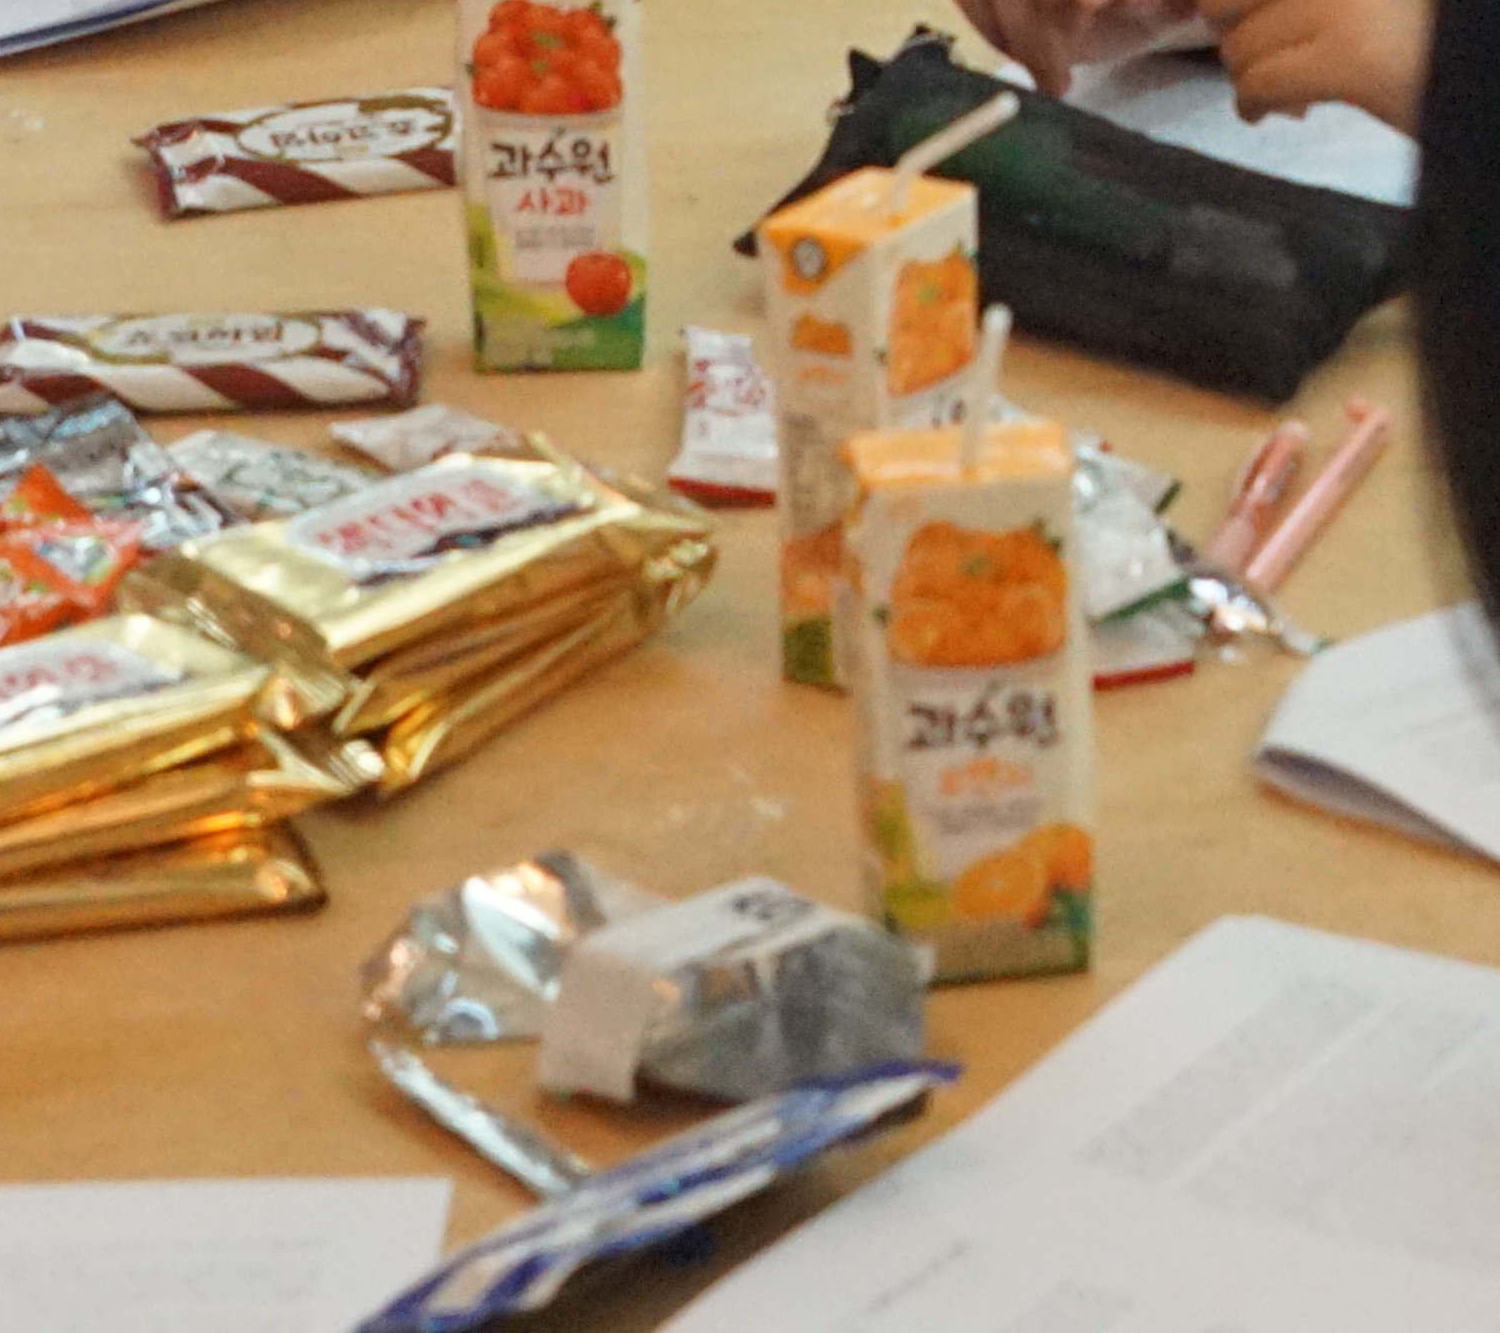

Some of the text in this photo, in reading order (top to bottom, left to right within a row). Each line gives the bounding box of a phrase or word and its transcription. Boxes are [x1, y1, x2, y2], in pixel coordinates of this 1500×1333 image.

[487, 137, 616, 186] 과수원
[516, 187, 590, 217] 사과
[903, 691, 1061, 752] 과수원
